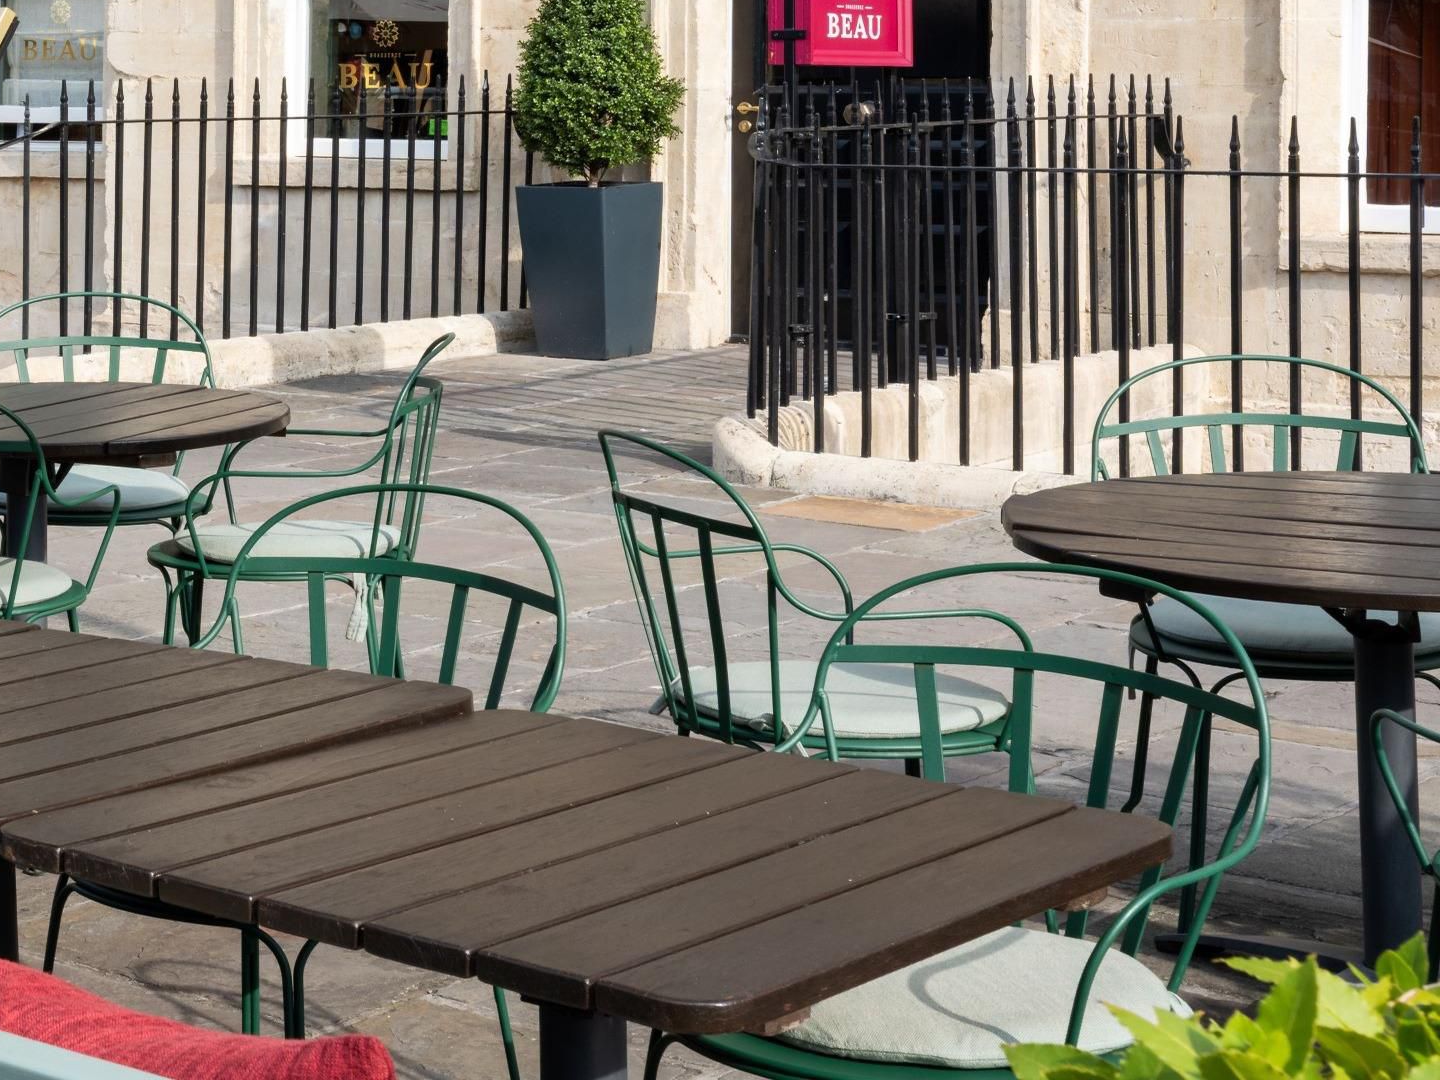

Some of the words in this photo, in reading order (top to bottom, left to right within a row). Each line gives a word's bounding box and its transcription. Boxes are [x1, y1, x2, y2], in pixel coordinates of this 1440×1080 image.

[826, 12, 882, 40] BEAU
[22, 37, 97, 62] BEAU
[338, 62, 434, 89] BEAU
